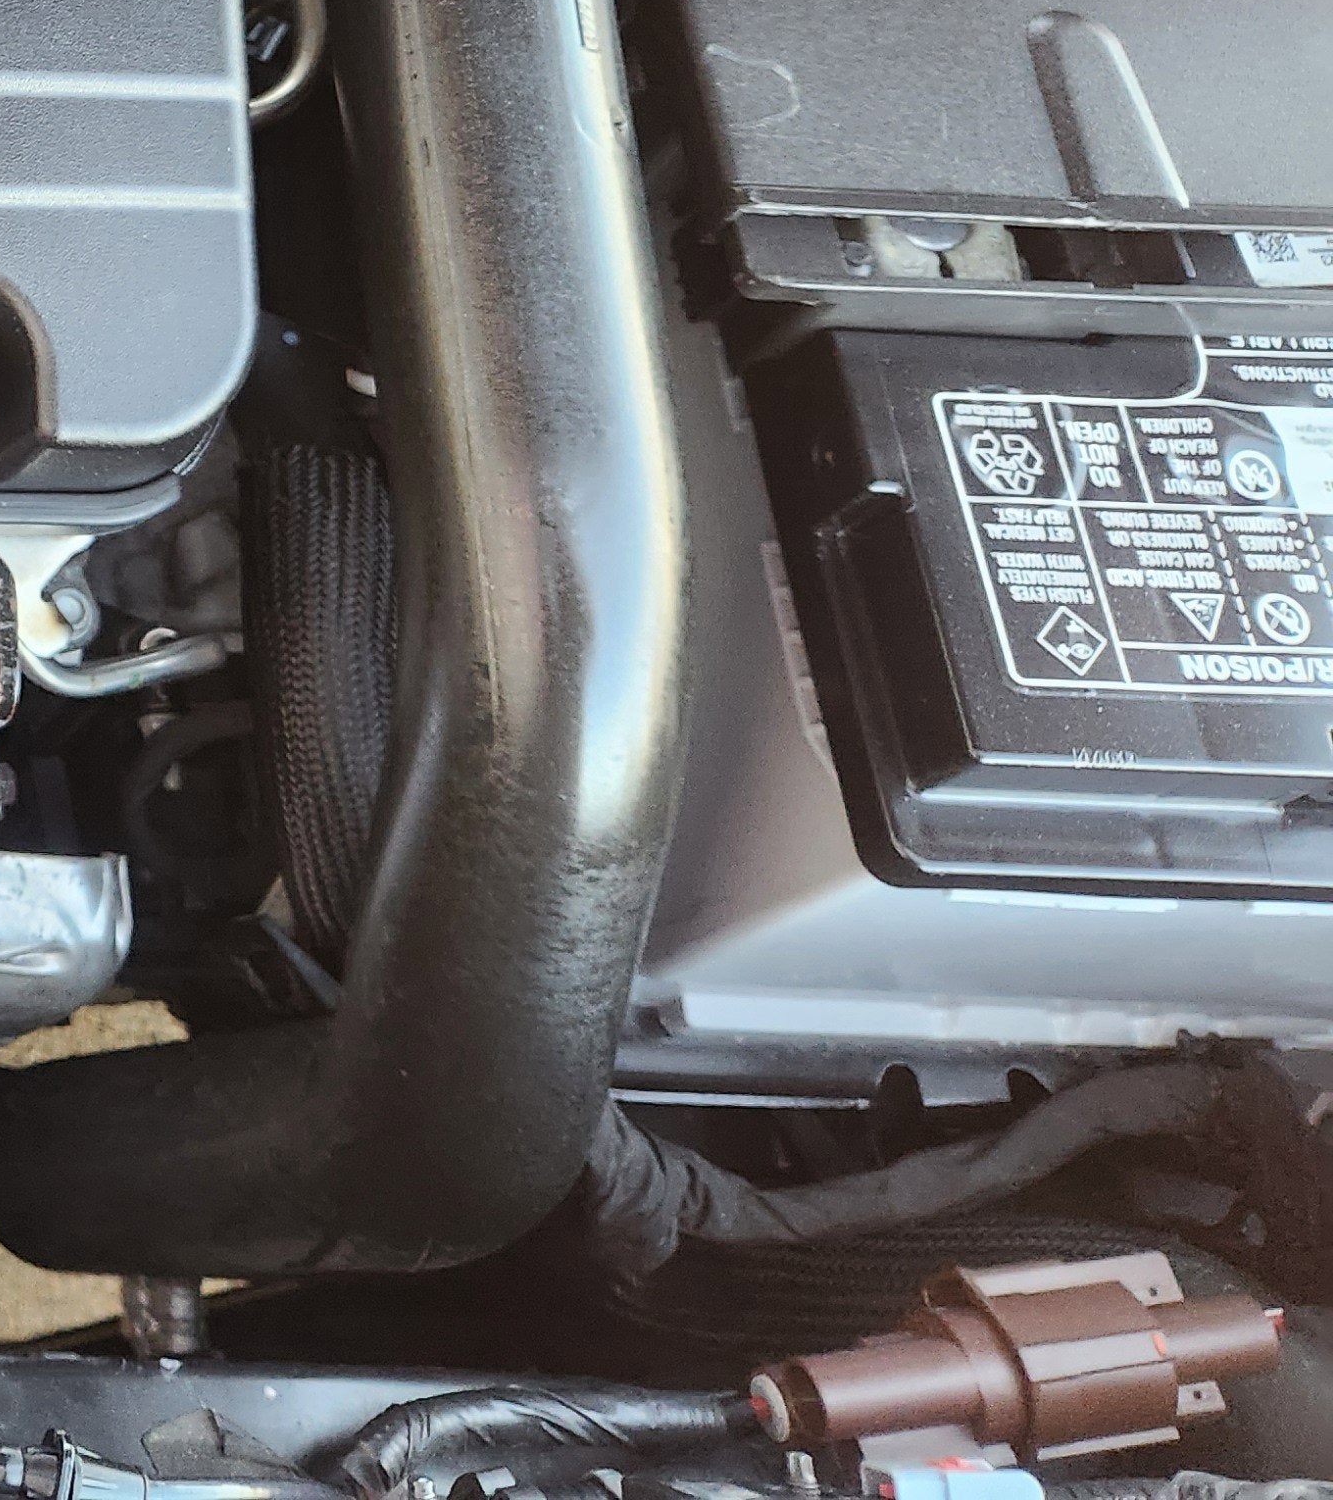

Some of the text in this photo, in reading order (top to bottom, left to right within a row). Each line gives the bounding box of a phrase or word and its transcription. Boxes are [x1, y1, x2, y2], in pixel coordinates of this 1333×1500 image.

[1058, 421, 1119, 443] OPEN.
[1079, 445, 1119, 464] NOT
[1148, 438, 1218, 454] REACH OF
[1202, 460, 1221, 475] OF
[1090, 466, 1121, 488] DO
[1163, 478, 1225, 496] KEEP OUT
[1034, 509, 1071, 524] HELP
[1048, 526, 1075, 542] GET
[1106, 568, 1222, 589] SULFURIC ACID
[1009, 585, 1094, 604] FLUSH EYES
